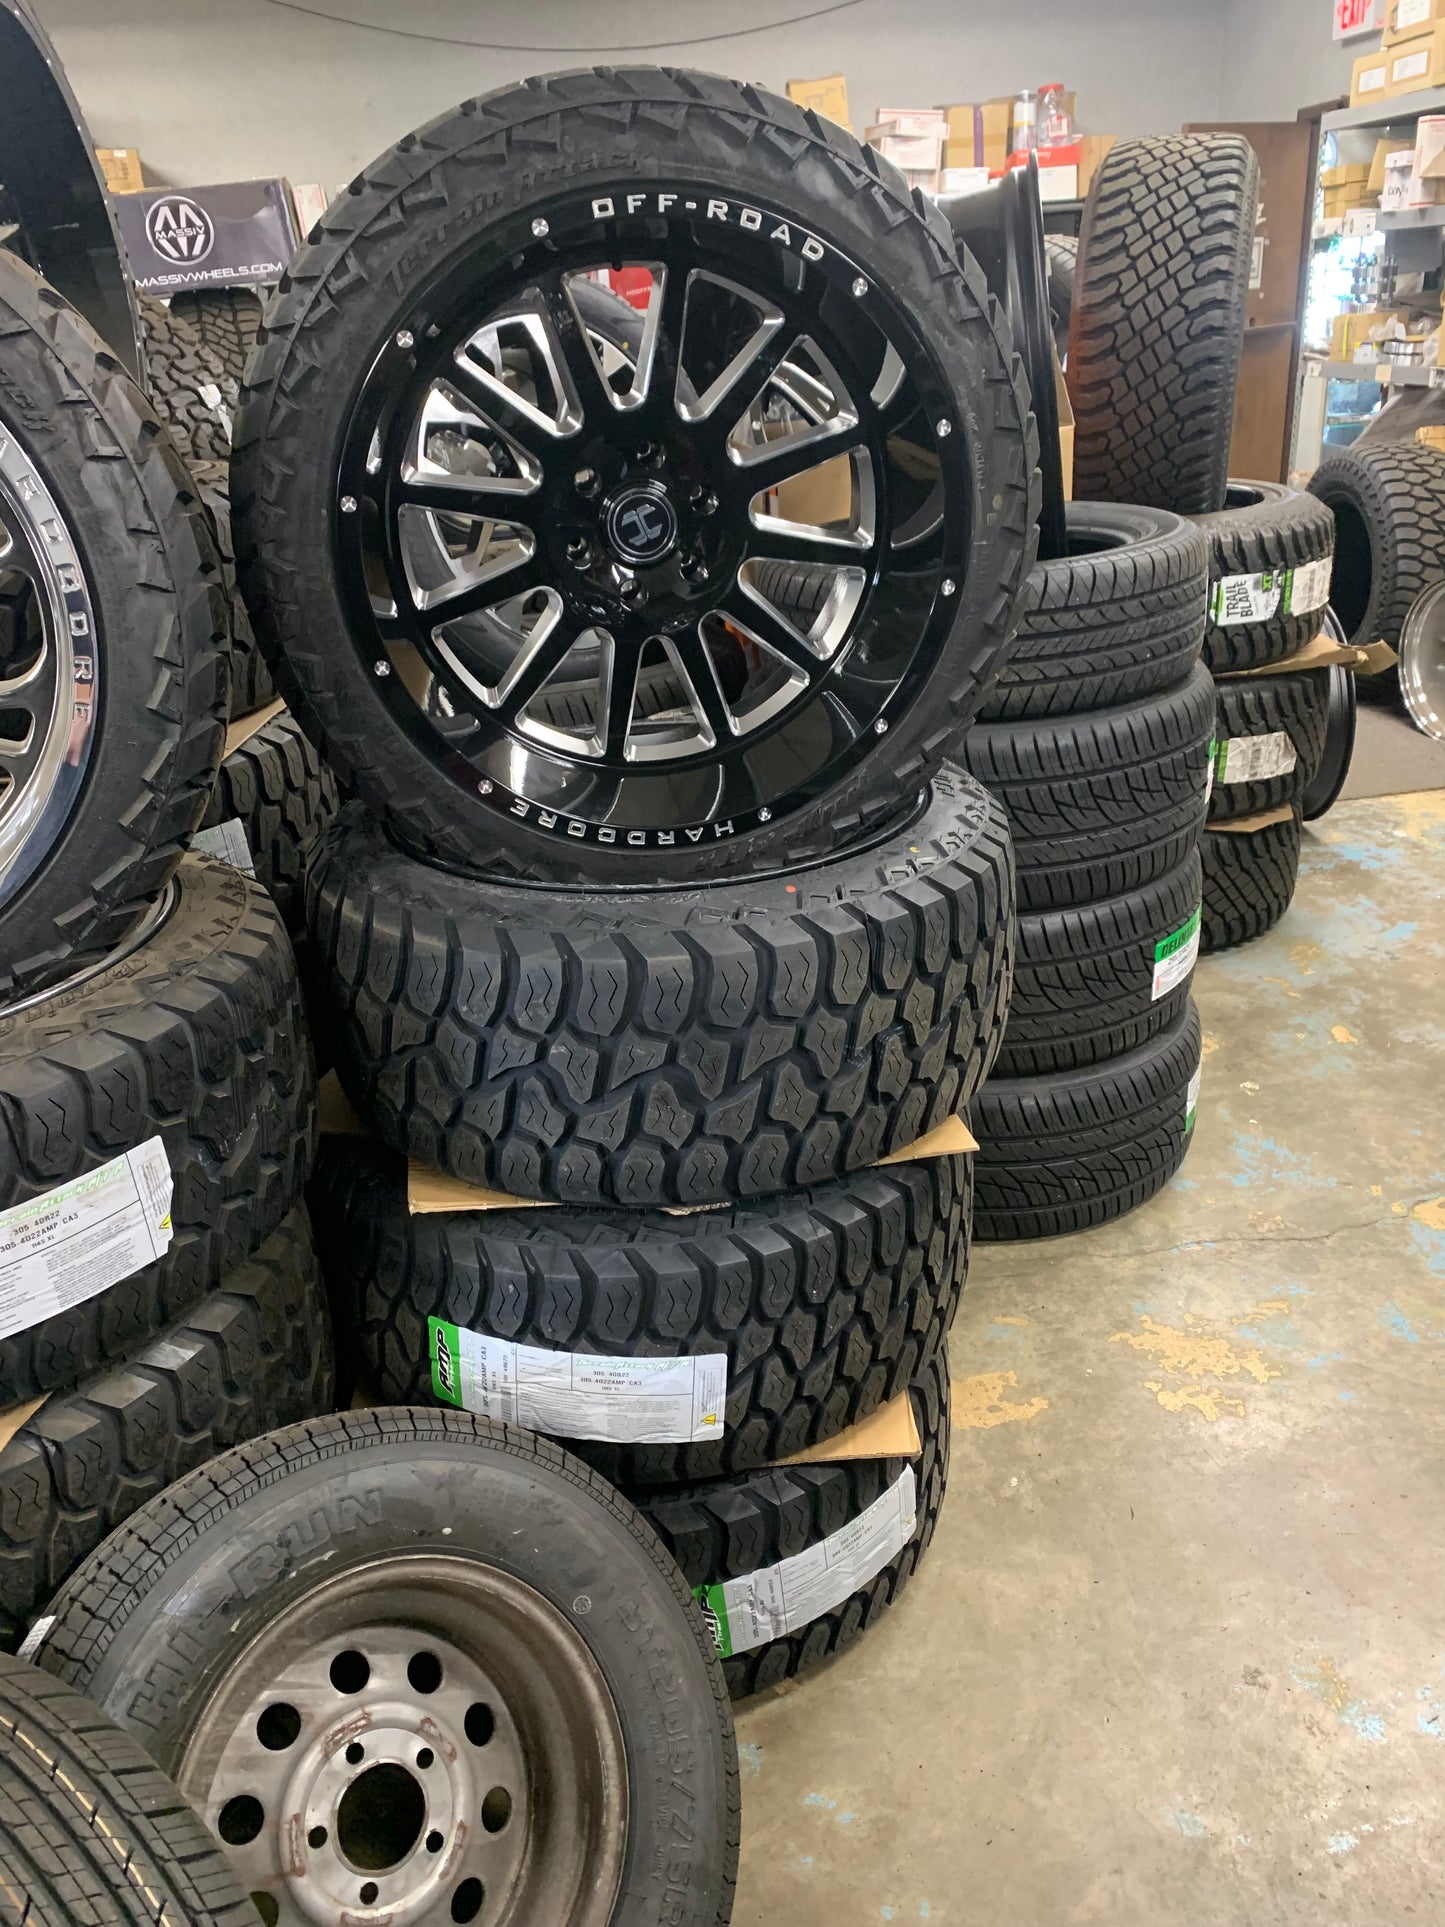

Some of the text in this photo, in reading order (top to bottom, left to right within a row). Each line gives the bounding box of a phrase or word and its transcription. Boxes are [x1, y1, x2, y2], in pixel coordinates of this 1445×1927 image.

[155, 227, 205, 240] MASSIV
[591, 194, 824, 261] OFF-ROAD
[135, 262, 283, 288] MASSIVWHEELS.COM
[1226, 584, 1239, 617] TRAIL
[1237, 580, 1254, 617] BLADE
[510, 798, 734, 845] HARDCORE
[35, 1210, 60, 1227] 40R22
[436, 1326, 455, 1398] AMP
